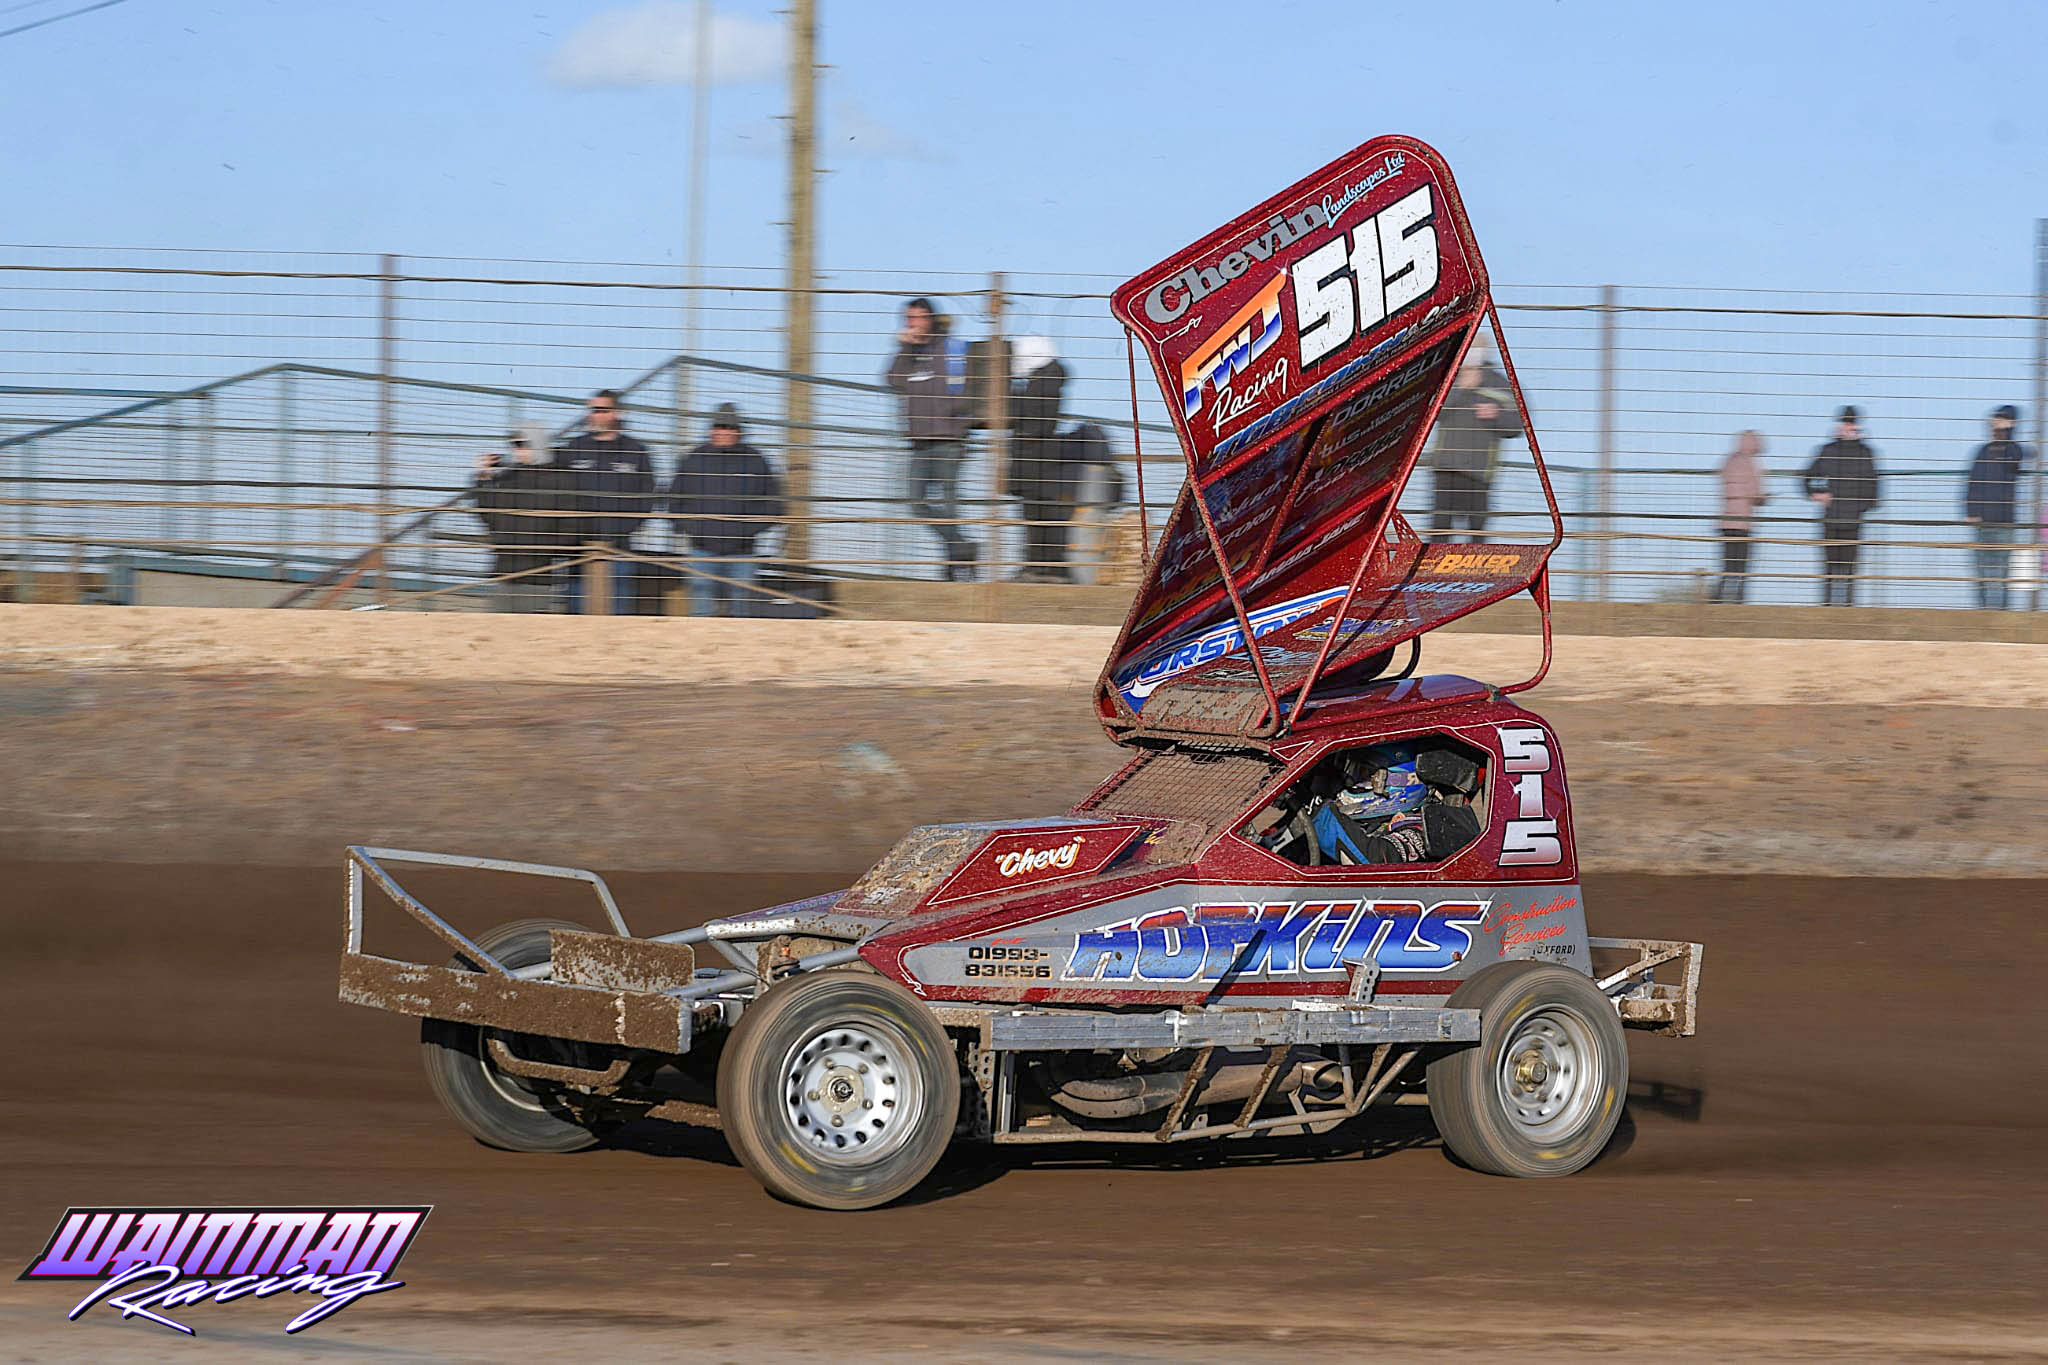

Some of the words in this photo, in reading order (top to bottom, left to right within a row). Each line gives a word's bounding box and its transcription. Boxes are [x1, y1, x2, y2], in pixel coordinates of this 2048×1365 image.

[1144, 204, 1327, 325] Chevin
[1321, 165, 1389, 229] Landscapes
[1291, 181, 1441, 374] 515
[1208, 357, 1289, 438] Racing
[1331, 349, 1446, 429] DORRELL
[1432, 553, 1521, 575] BAKER
[1482, 892, 1578, 934] Construction
[1498, 919, 1568, 956] Services
